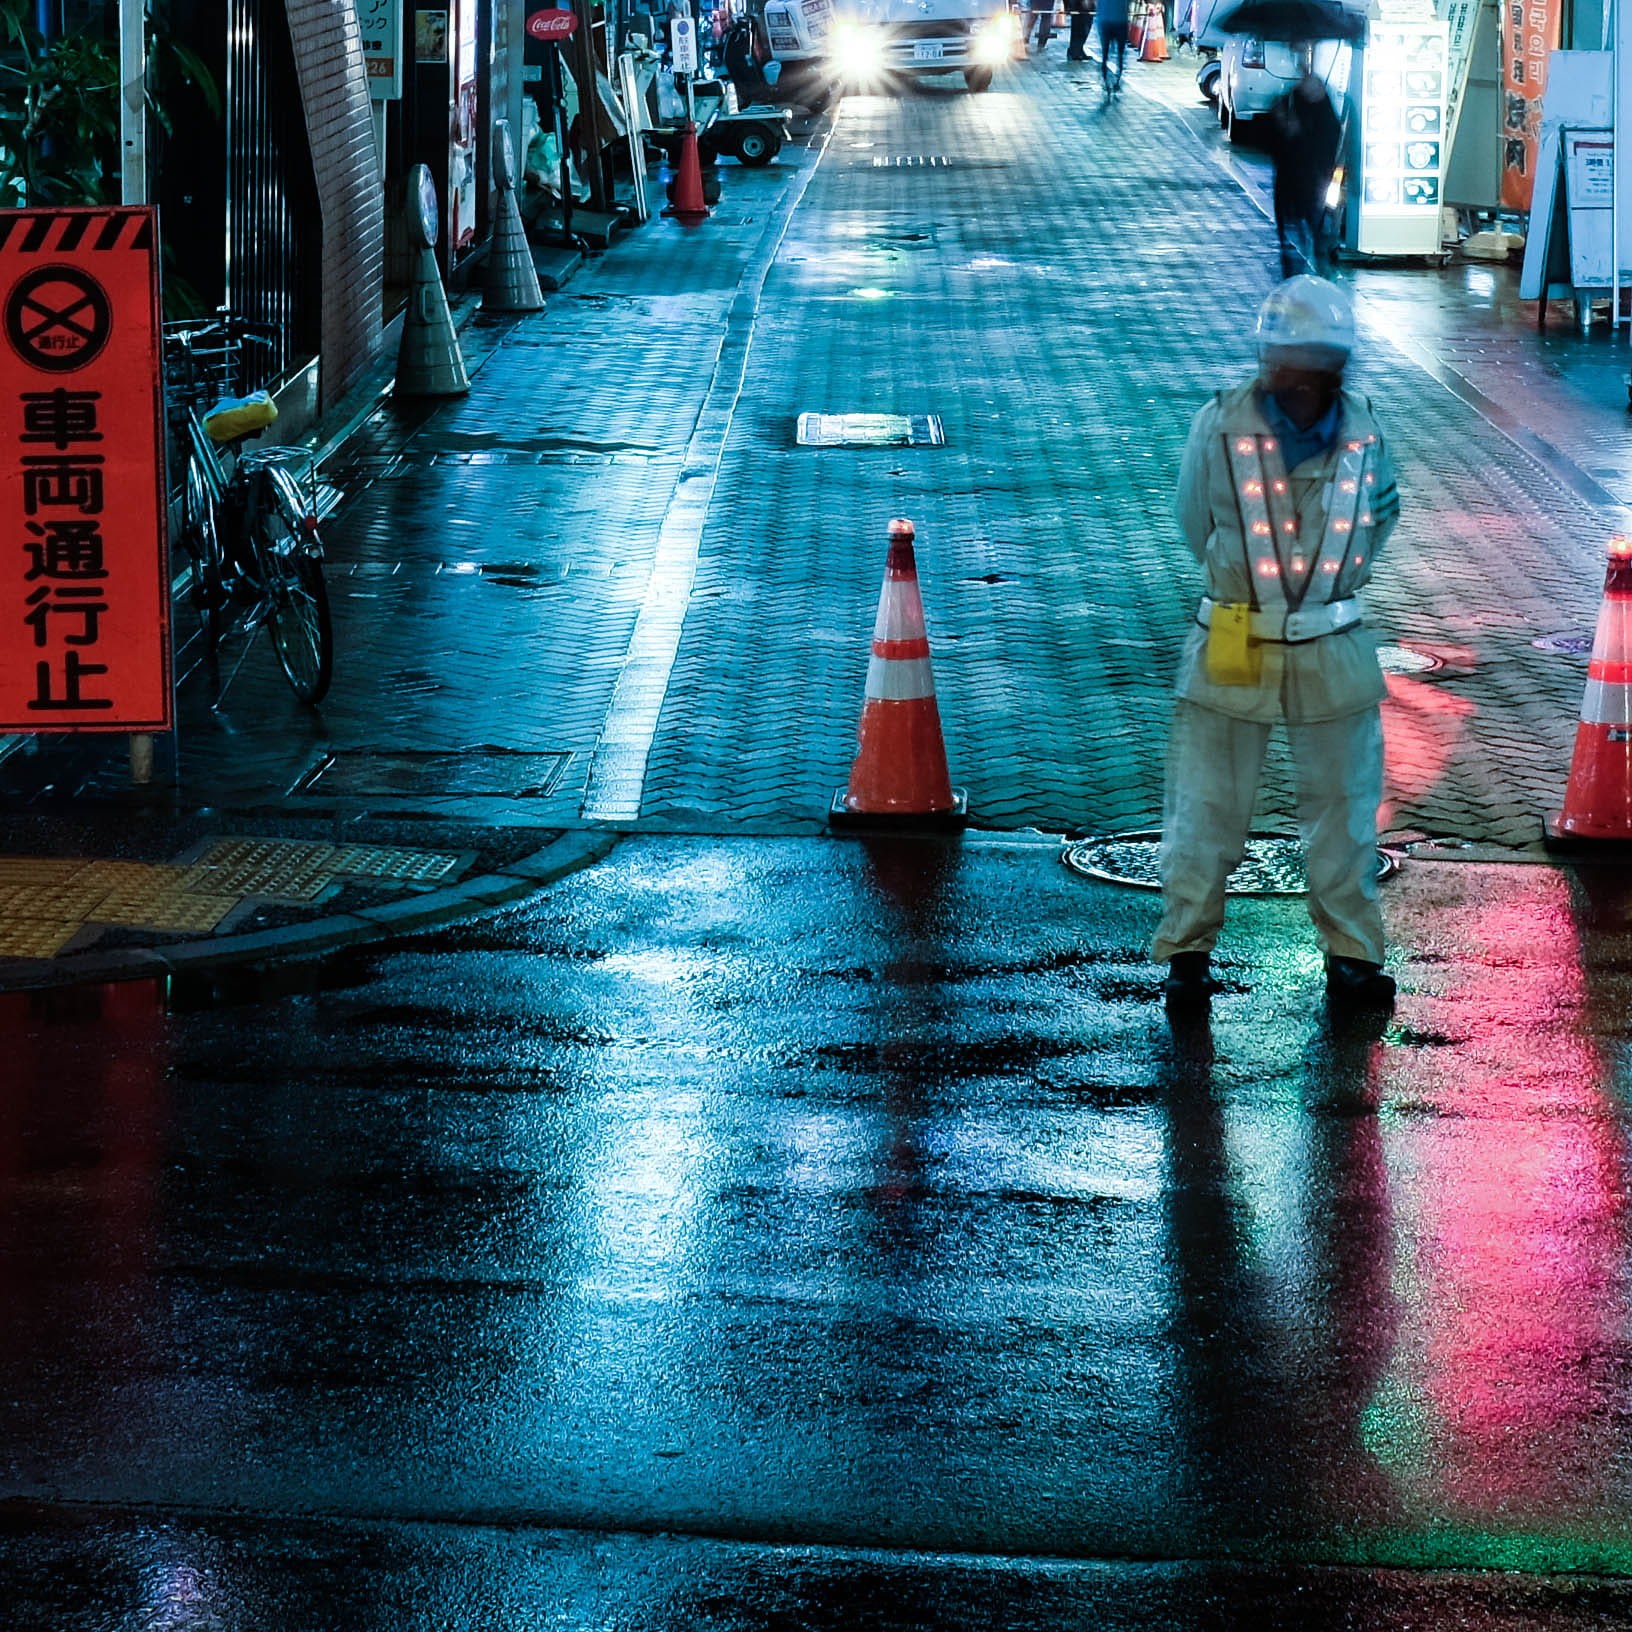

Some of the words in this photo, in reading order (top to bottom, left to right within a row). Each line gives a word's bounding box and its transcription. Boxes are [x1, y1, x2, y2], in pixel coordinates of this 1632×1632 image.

[37, 334, 81, 350] 通行止
[18, 387, 114, 711] 車両通行止
